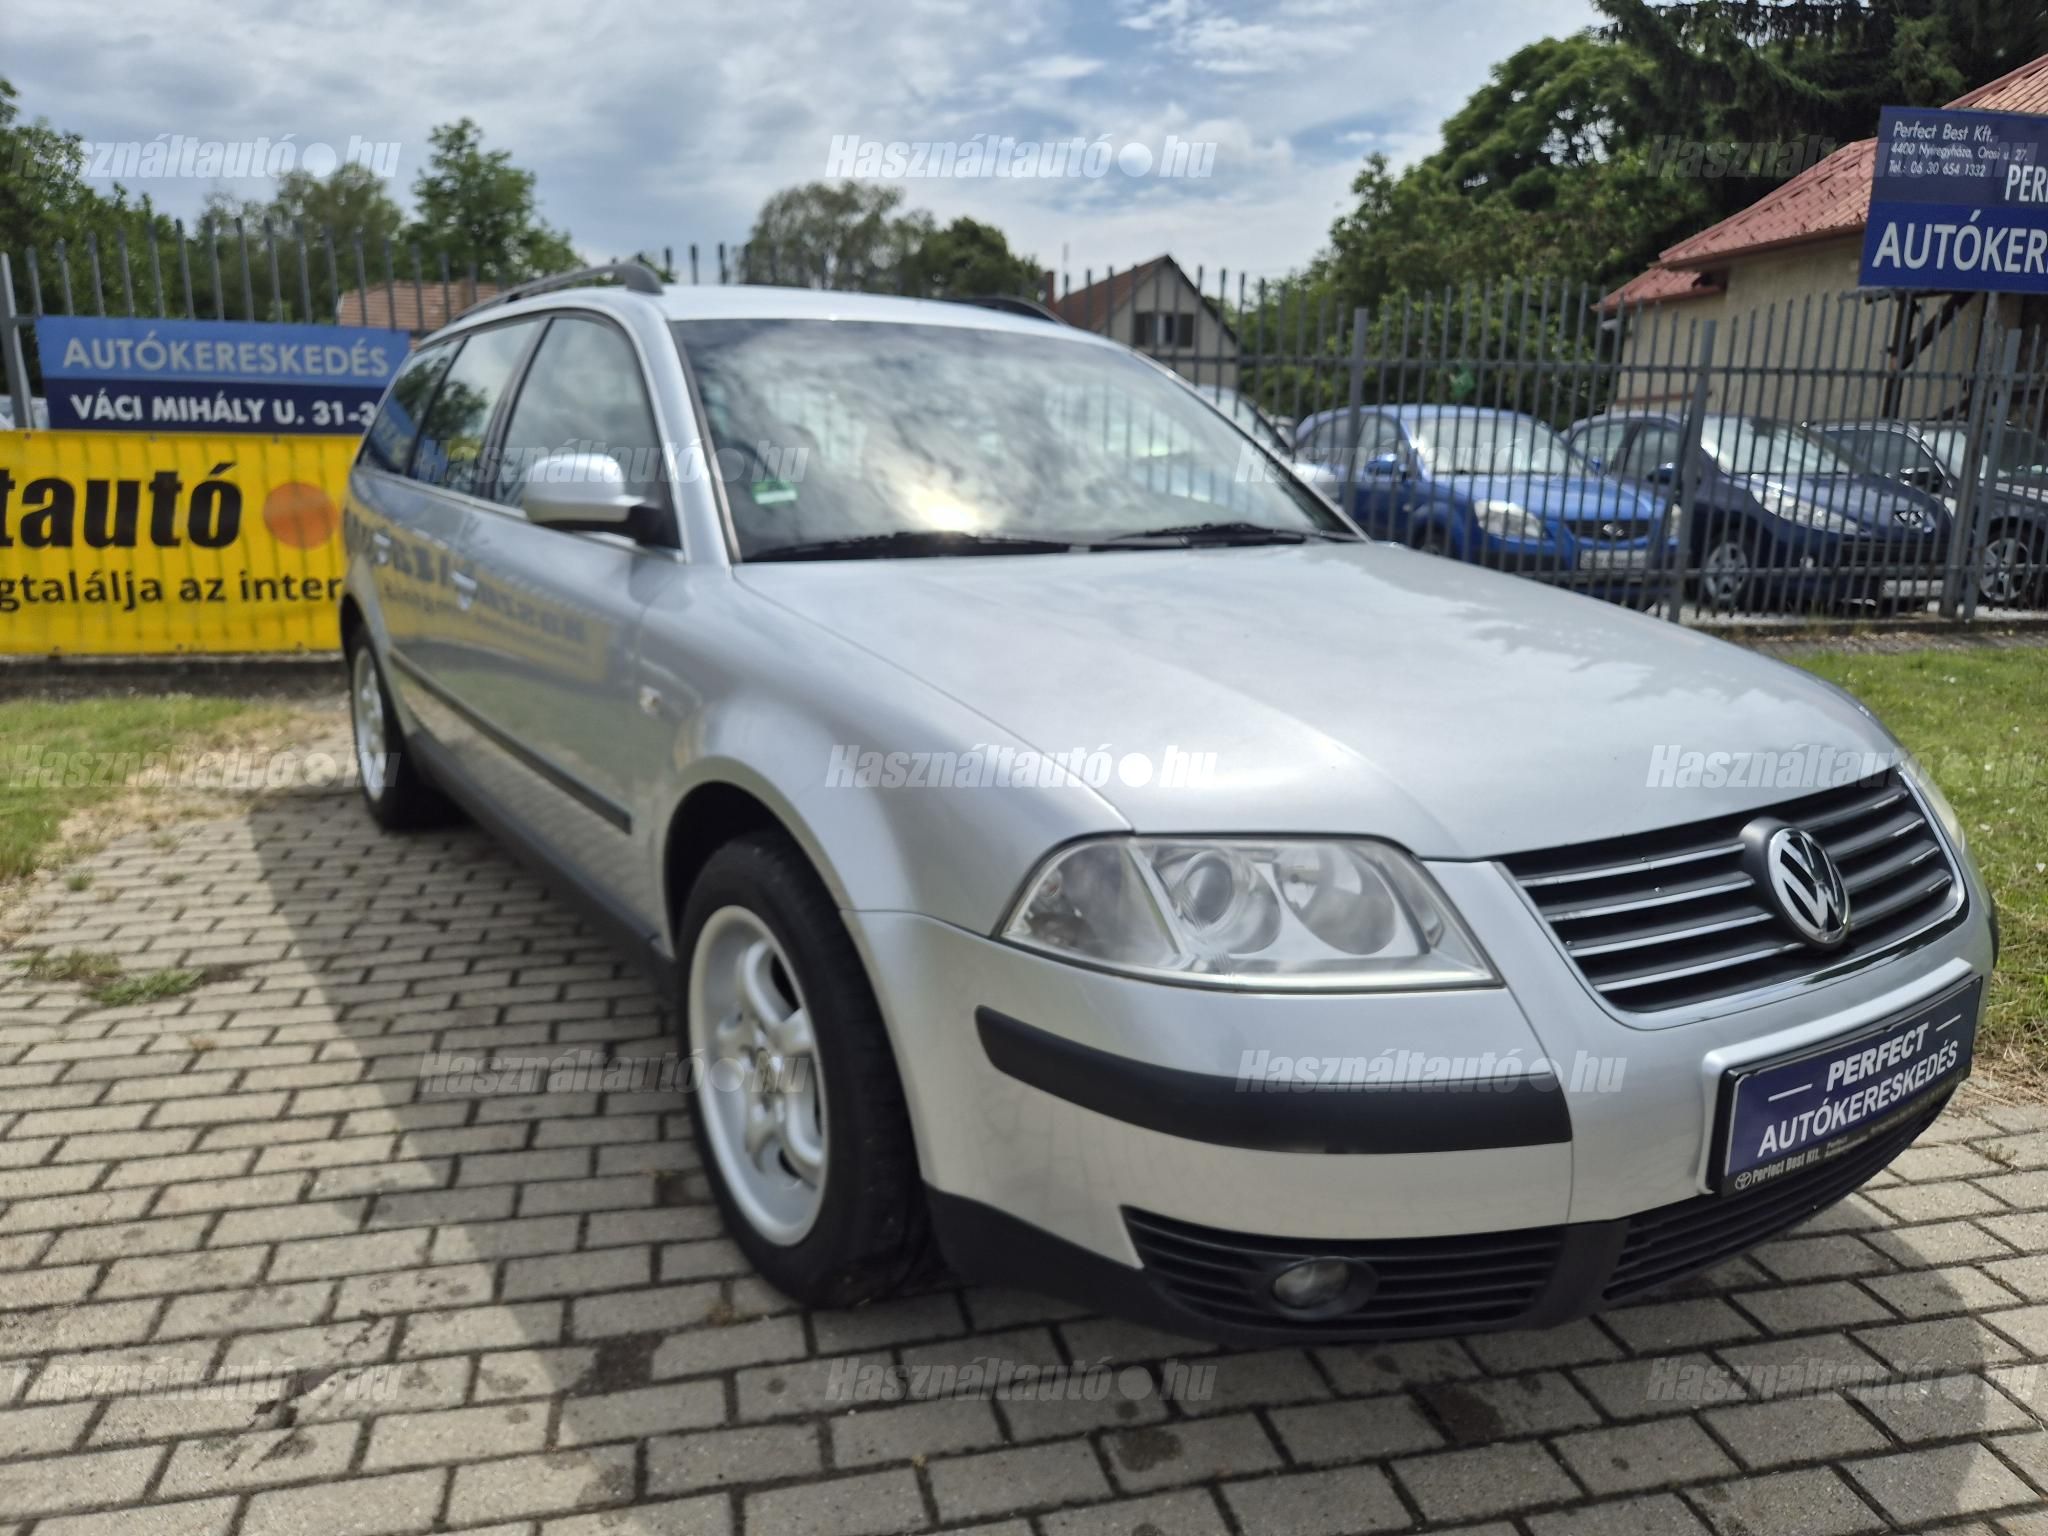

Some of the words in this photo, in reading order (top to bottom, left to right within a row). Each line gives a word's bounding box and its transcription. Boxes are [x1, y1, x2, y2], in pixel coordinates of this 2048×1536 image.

[1893, 121, 1937, 139] Perfect
[1942, 123, 1968, 141] Best
[1974, 125, 1993, 142] Kft.
[1910, 161, 1923, 174] 06
[1926, 162, 1939, 174] 30
[1942, 162, 1960, 175] 654
[2005, 164, 2048, 202] PER
[1872, 209, 2048, 274] AUTÓKER
[63, 330, 389, 377] AUTÓKERESKEDÉS
[70, 388, 143, 421] VÁCI
[152, 391, 265, 424] MIHÁLY
[273, 401, 305, 425] U.
[179, 575, 227, 601] az
[1826, 1022, 1929, 1092] PERFECT
[1758, 1040, 1959, 1158] AUTÓKERESKEDÉS
